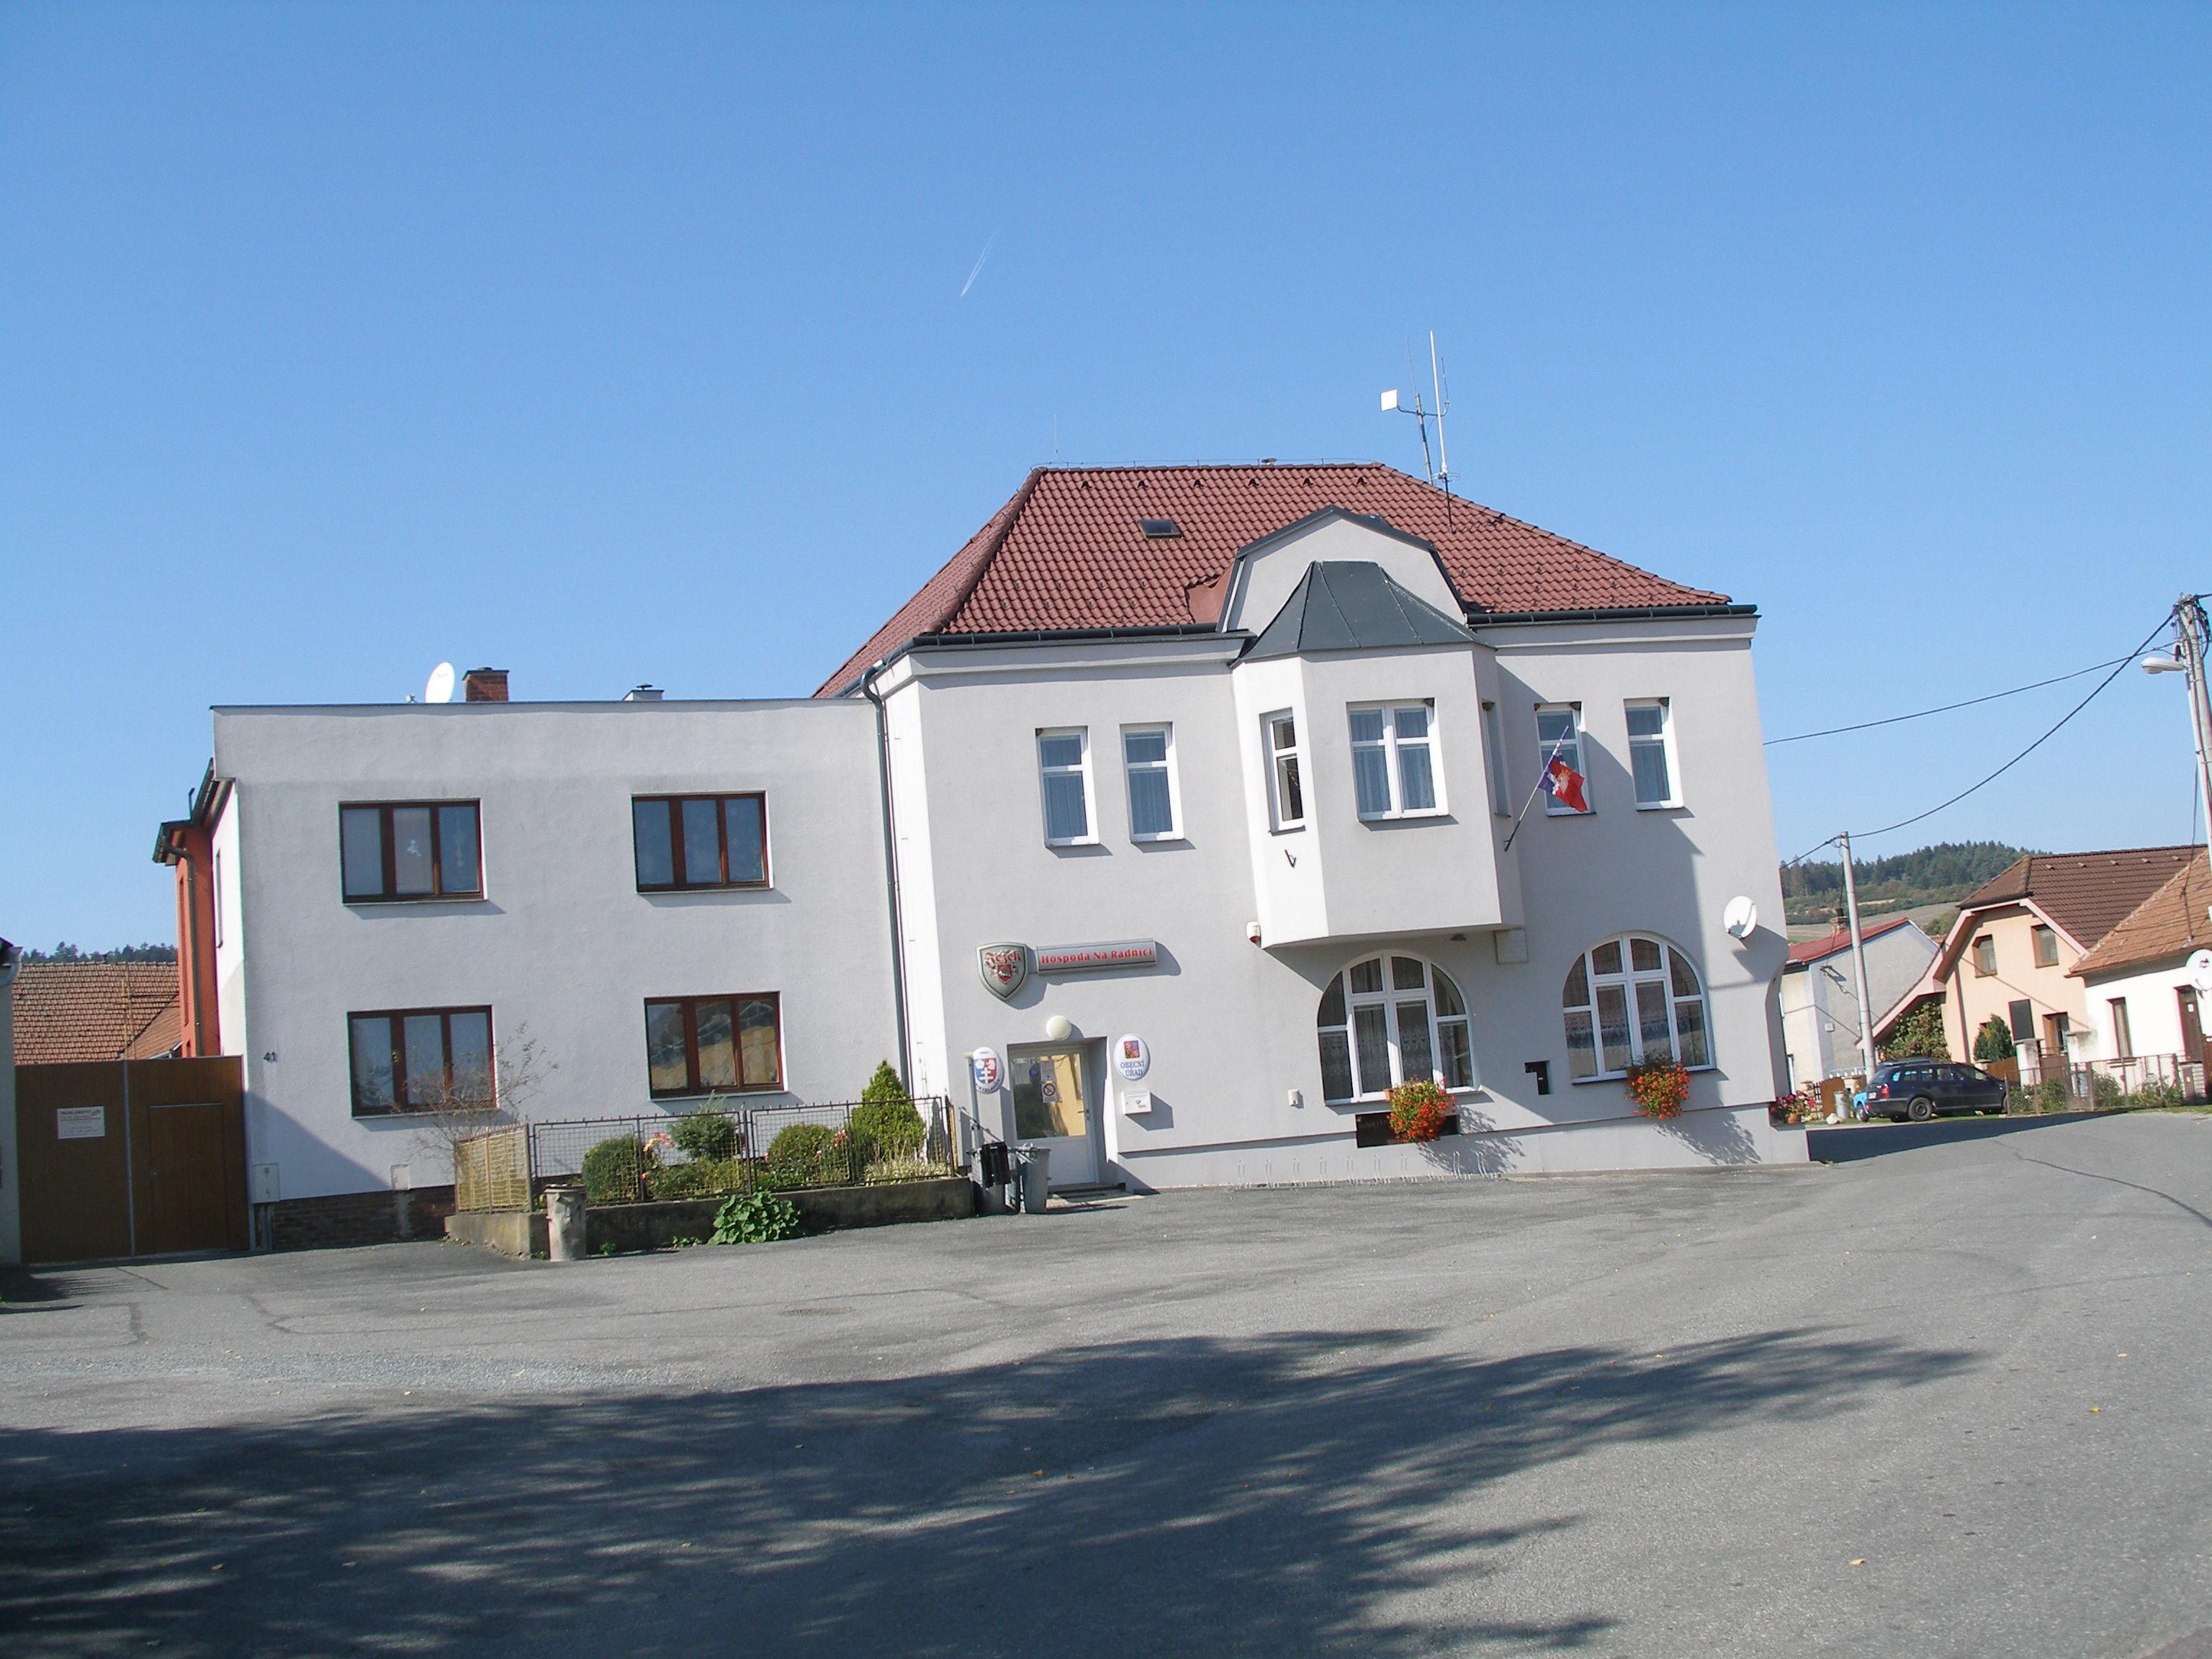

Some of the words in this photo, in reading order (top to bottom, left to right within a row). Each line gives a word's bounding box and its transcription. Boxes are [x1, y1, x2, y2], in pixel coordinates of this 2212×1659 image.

[1041, 951, 1090, 963] Hospoda
[1094, 951, 1107, 960] Na
[1111, 946, 1153, 958] Radnici
